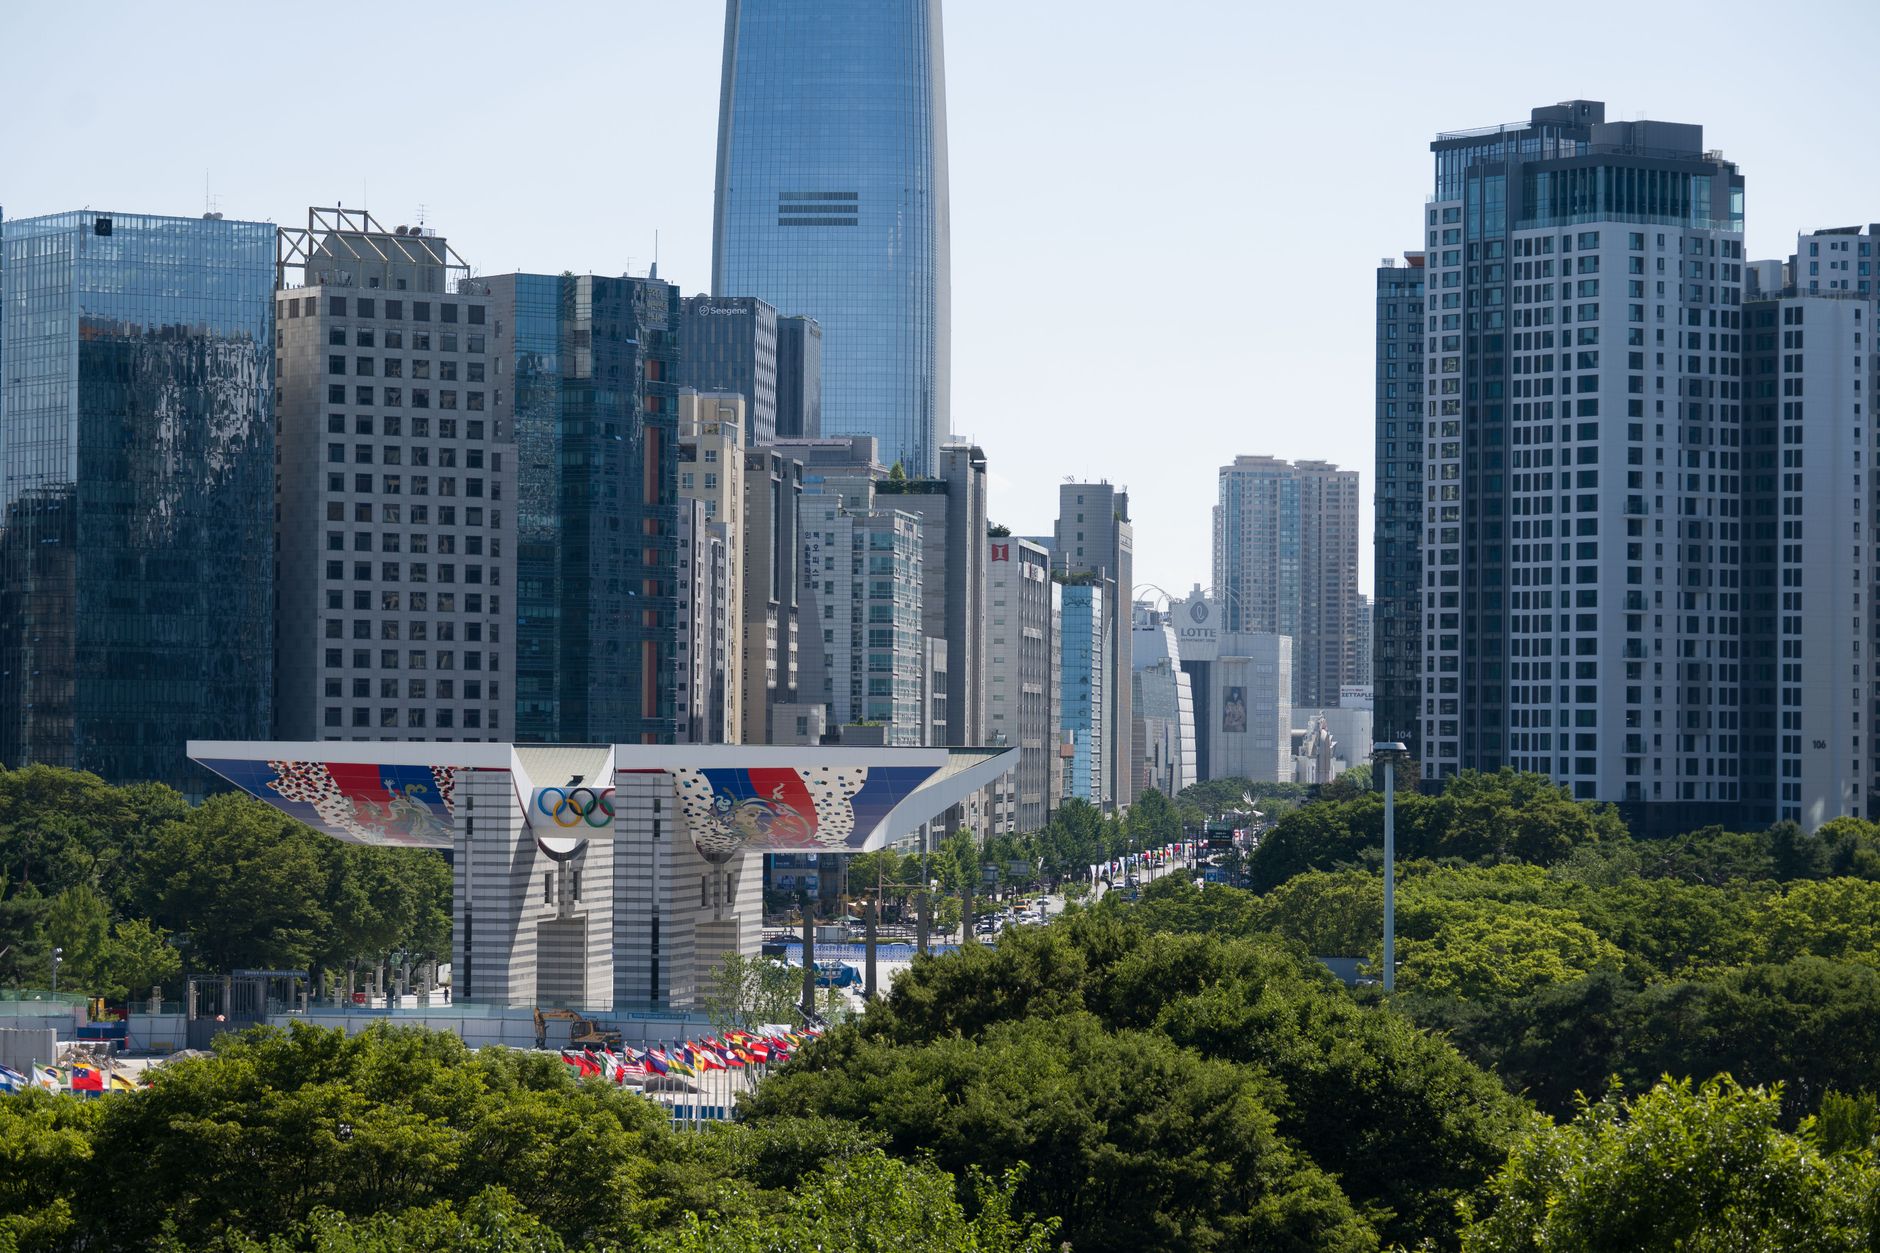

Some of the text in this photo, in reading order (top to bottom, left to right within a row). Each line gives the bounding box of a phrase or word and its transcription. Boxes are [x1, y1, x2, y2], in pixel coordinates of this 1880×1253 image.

[710, 306, 748, 316] Seegene
[1181, 628, 1216, 637] LOTTE
[1396, 730, 1412, 739] 104
[1812, 740, 1826, 749] 106
